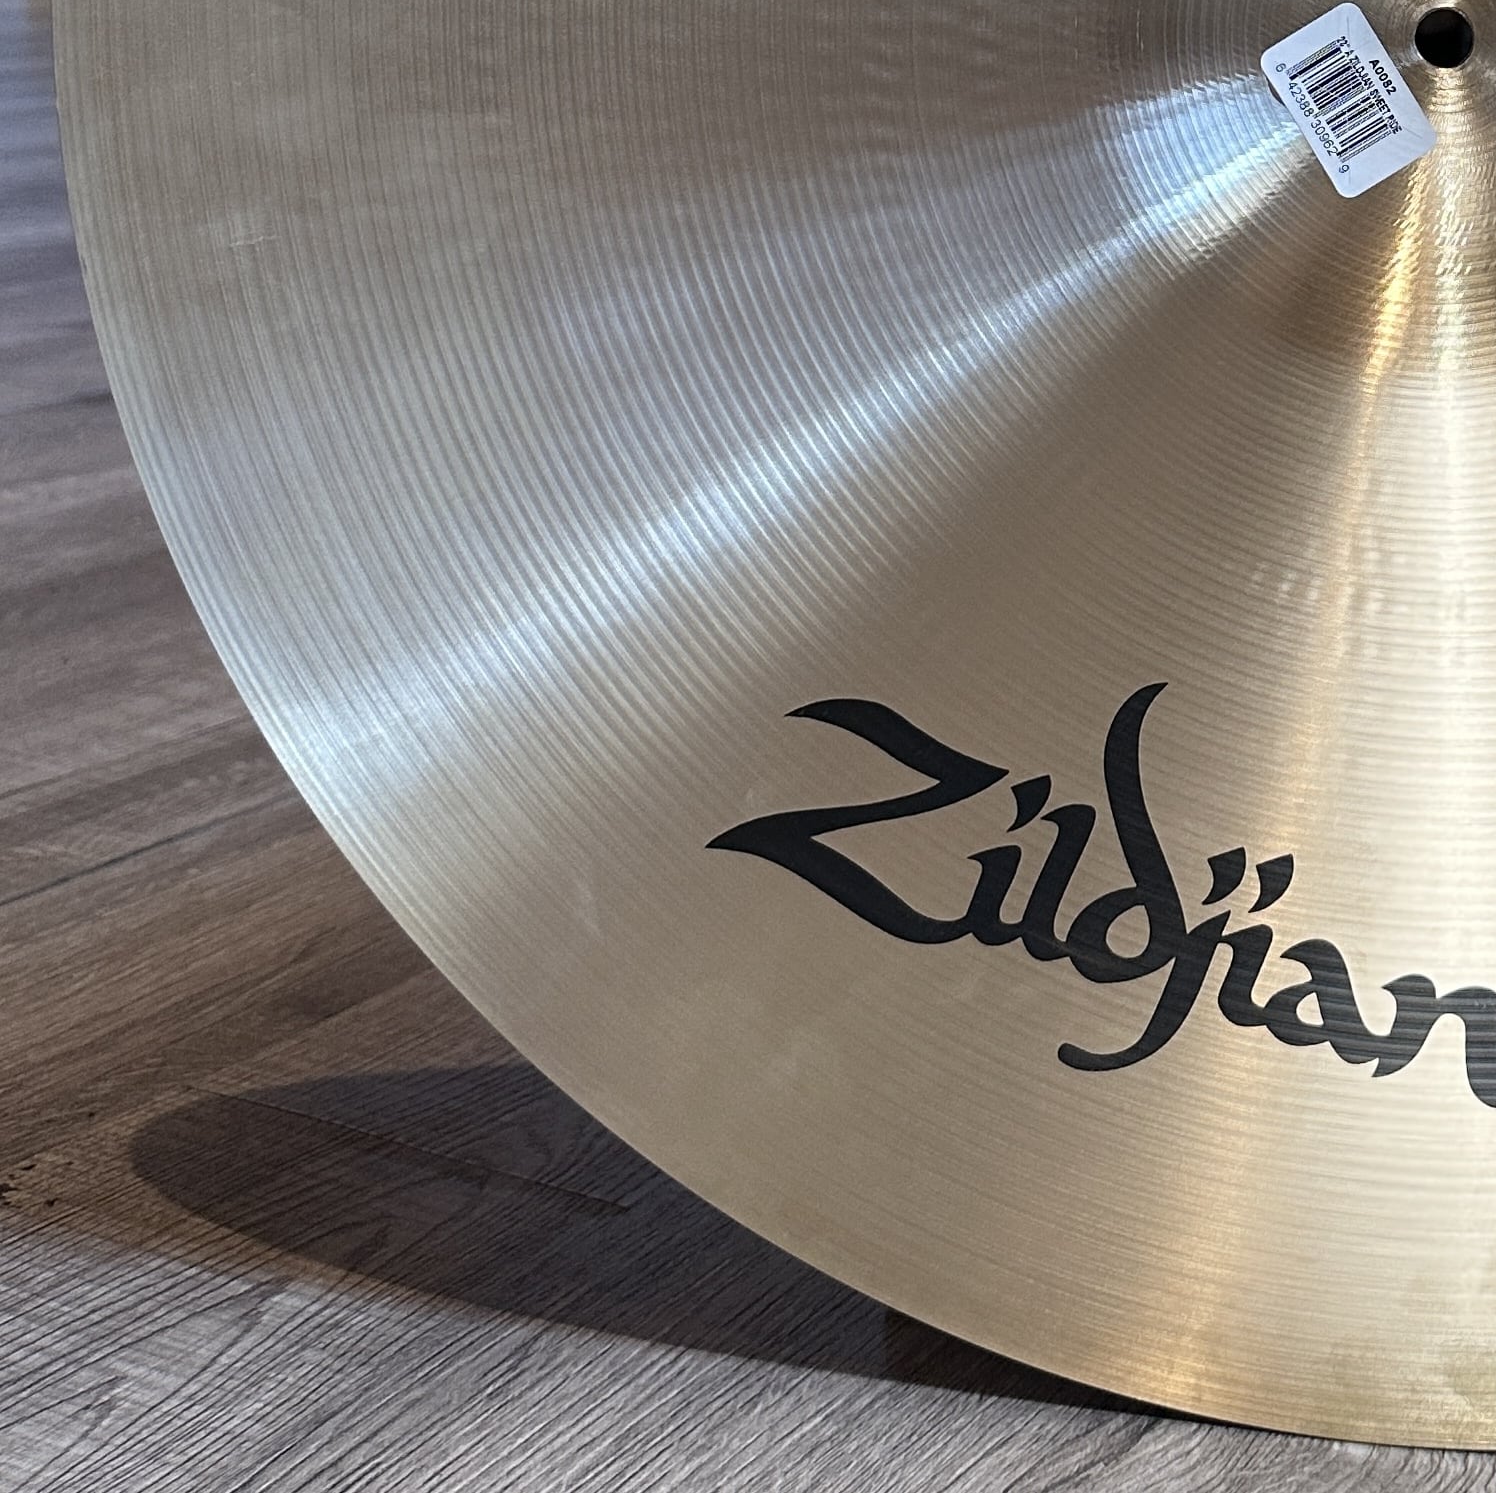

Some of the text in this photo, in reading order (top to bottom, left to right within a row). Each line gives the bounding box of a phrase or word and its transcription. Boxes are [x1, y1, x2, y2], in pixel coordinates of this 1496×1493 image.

[1369, 59, 1397, 95] A0082
[1275, 63, 1350, 174] 6 42388 30962 9
[1368, 88, 1391, 117] SWEET
